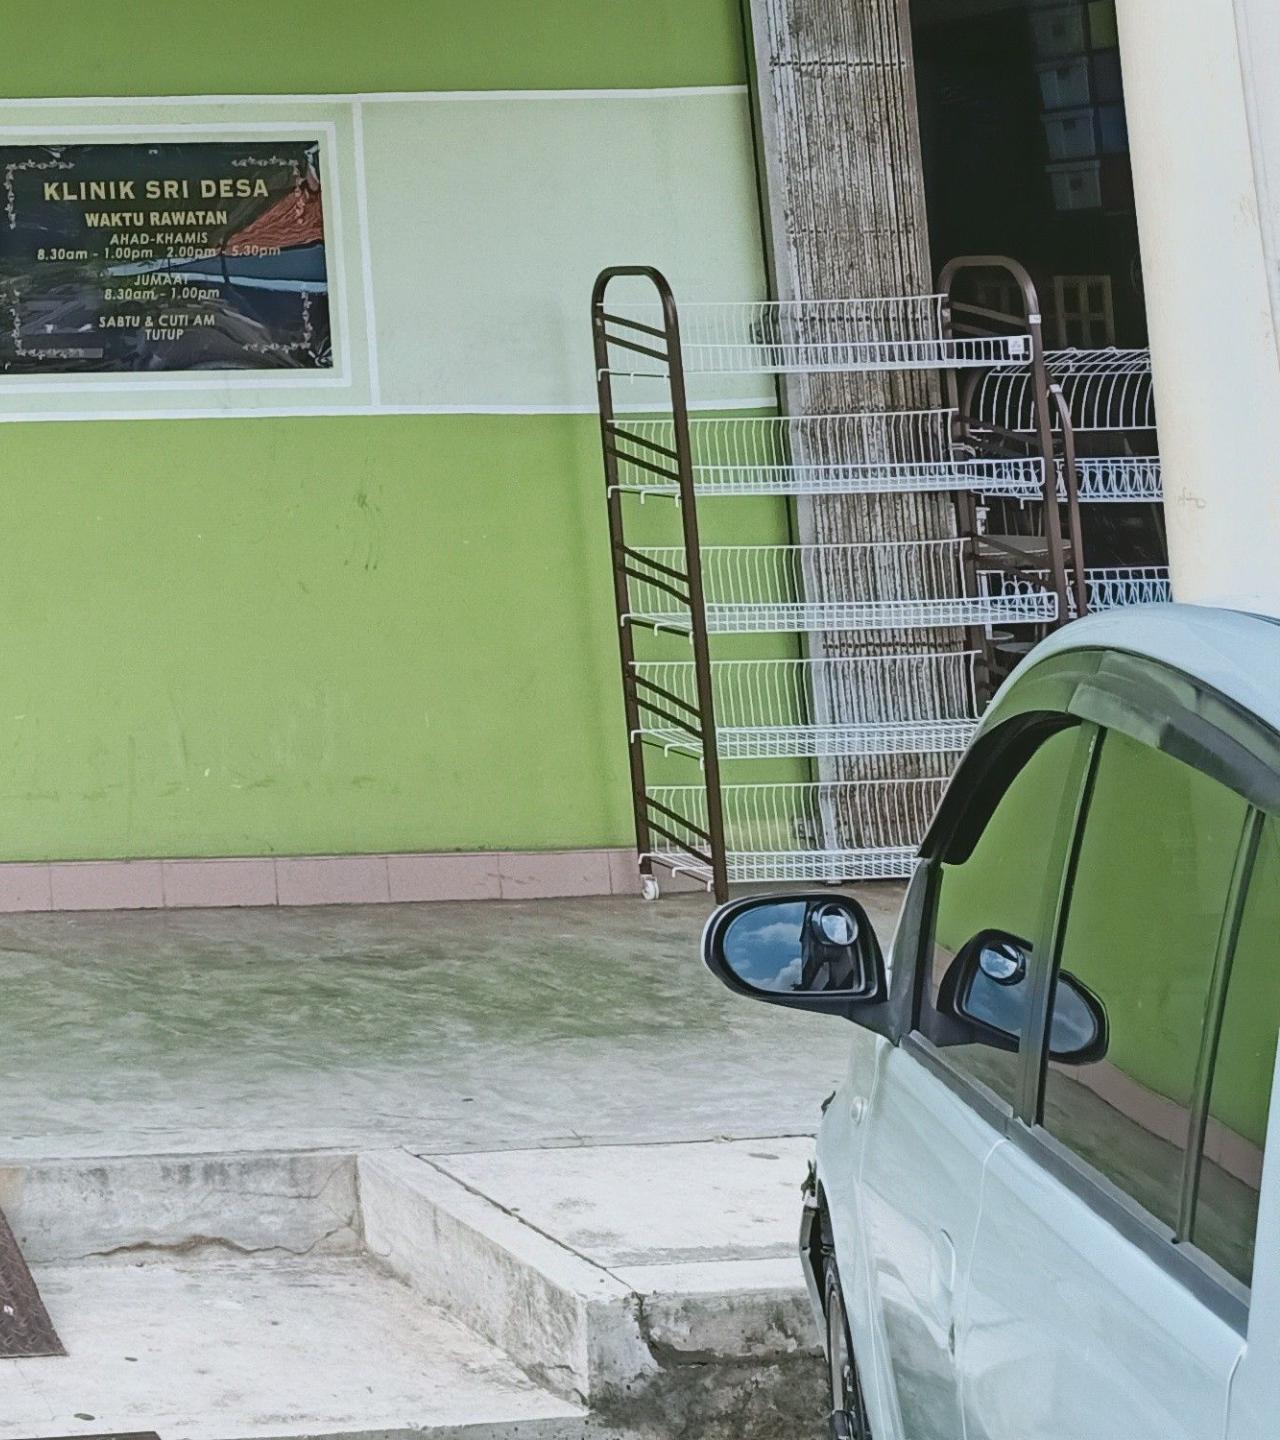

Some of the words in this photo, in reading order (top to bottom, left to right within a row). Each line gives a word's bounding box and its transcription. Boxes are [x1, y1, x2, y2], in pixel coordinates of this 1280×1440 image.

[43, 180, 136, 201] KLINIK
[145, 179, 189, 200] SRI
[200, 178, 269, 199] DESA
[84, 211, 144, 228] WAKTU
[149, 210, 228, 227] RAWATAN
[109, 232, 209, 246] AHAD-KHAMIS
[37, 248, 88, 261] 8.30am
[104, 246, 153, 261] 1.00pm
[166, 245, 217, 260] 2.00pm
[104, 288, 156, 301] 8.30am
[171, 287, 221, 302] 1.00pm
[98, 315, 141, 329] SABTU
[144, 314, 154, 328] &
[158, 314, 190, 328] CUTI
[192, 313, 216, 327] AM
[144, 328, 185, 341] TUTUP
